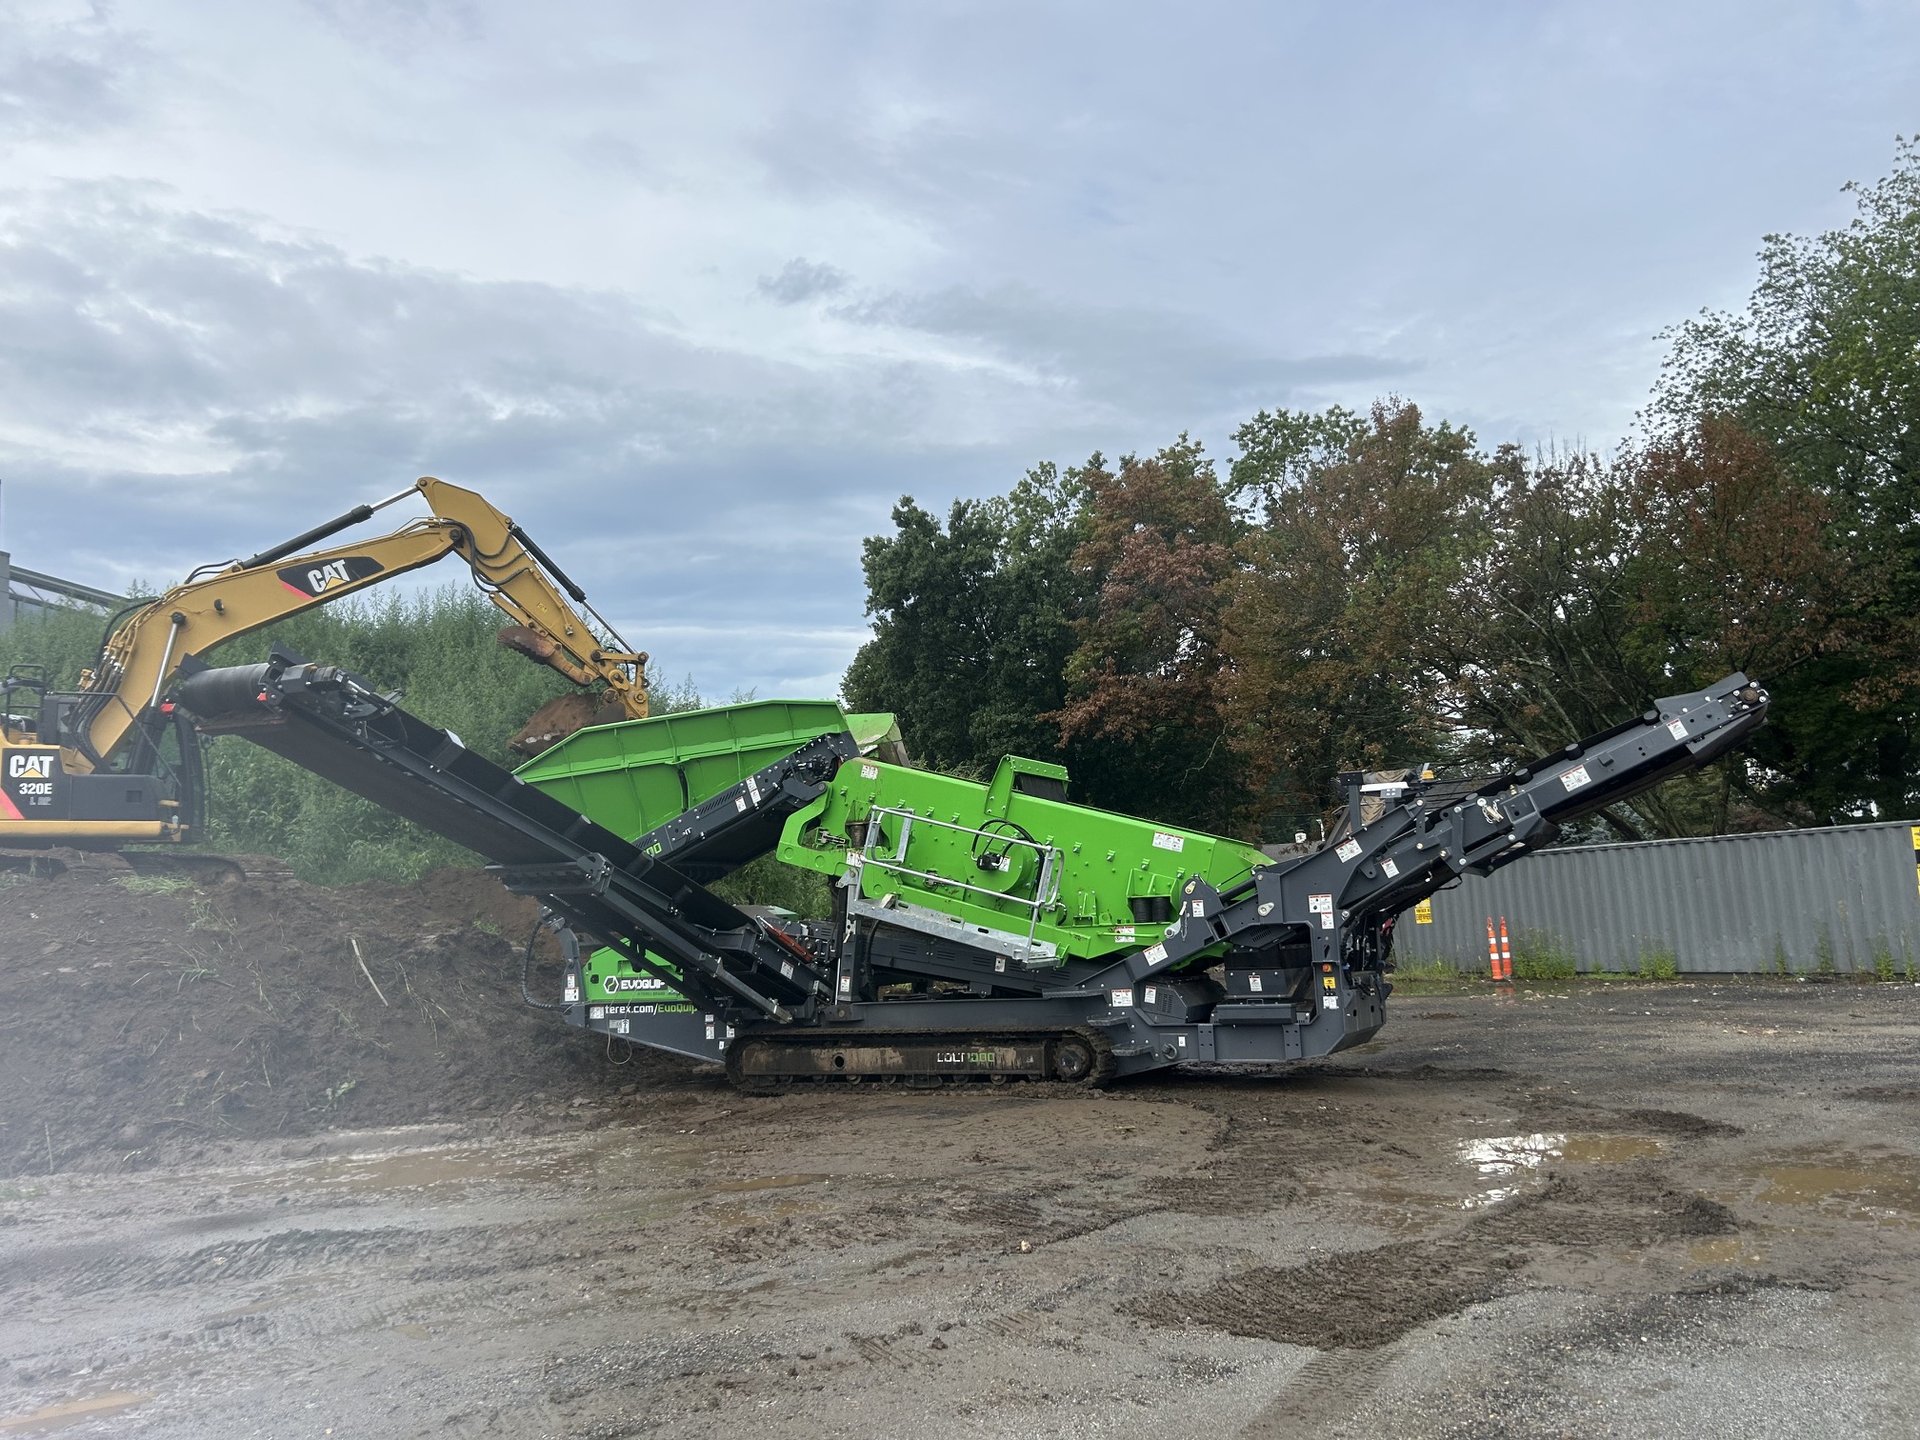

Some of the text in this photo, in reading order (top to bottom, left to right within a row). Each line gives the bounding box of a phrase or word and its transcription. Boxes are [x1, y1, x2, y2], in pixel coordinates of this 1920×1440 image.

[307, 559, 350, 593] CAT
[9, 755, 54, 778] CAT
[19, 783, 53, 795] 320E
